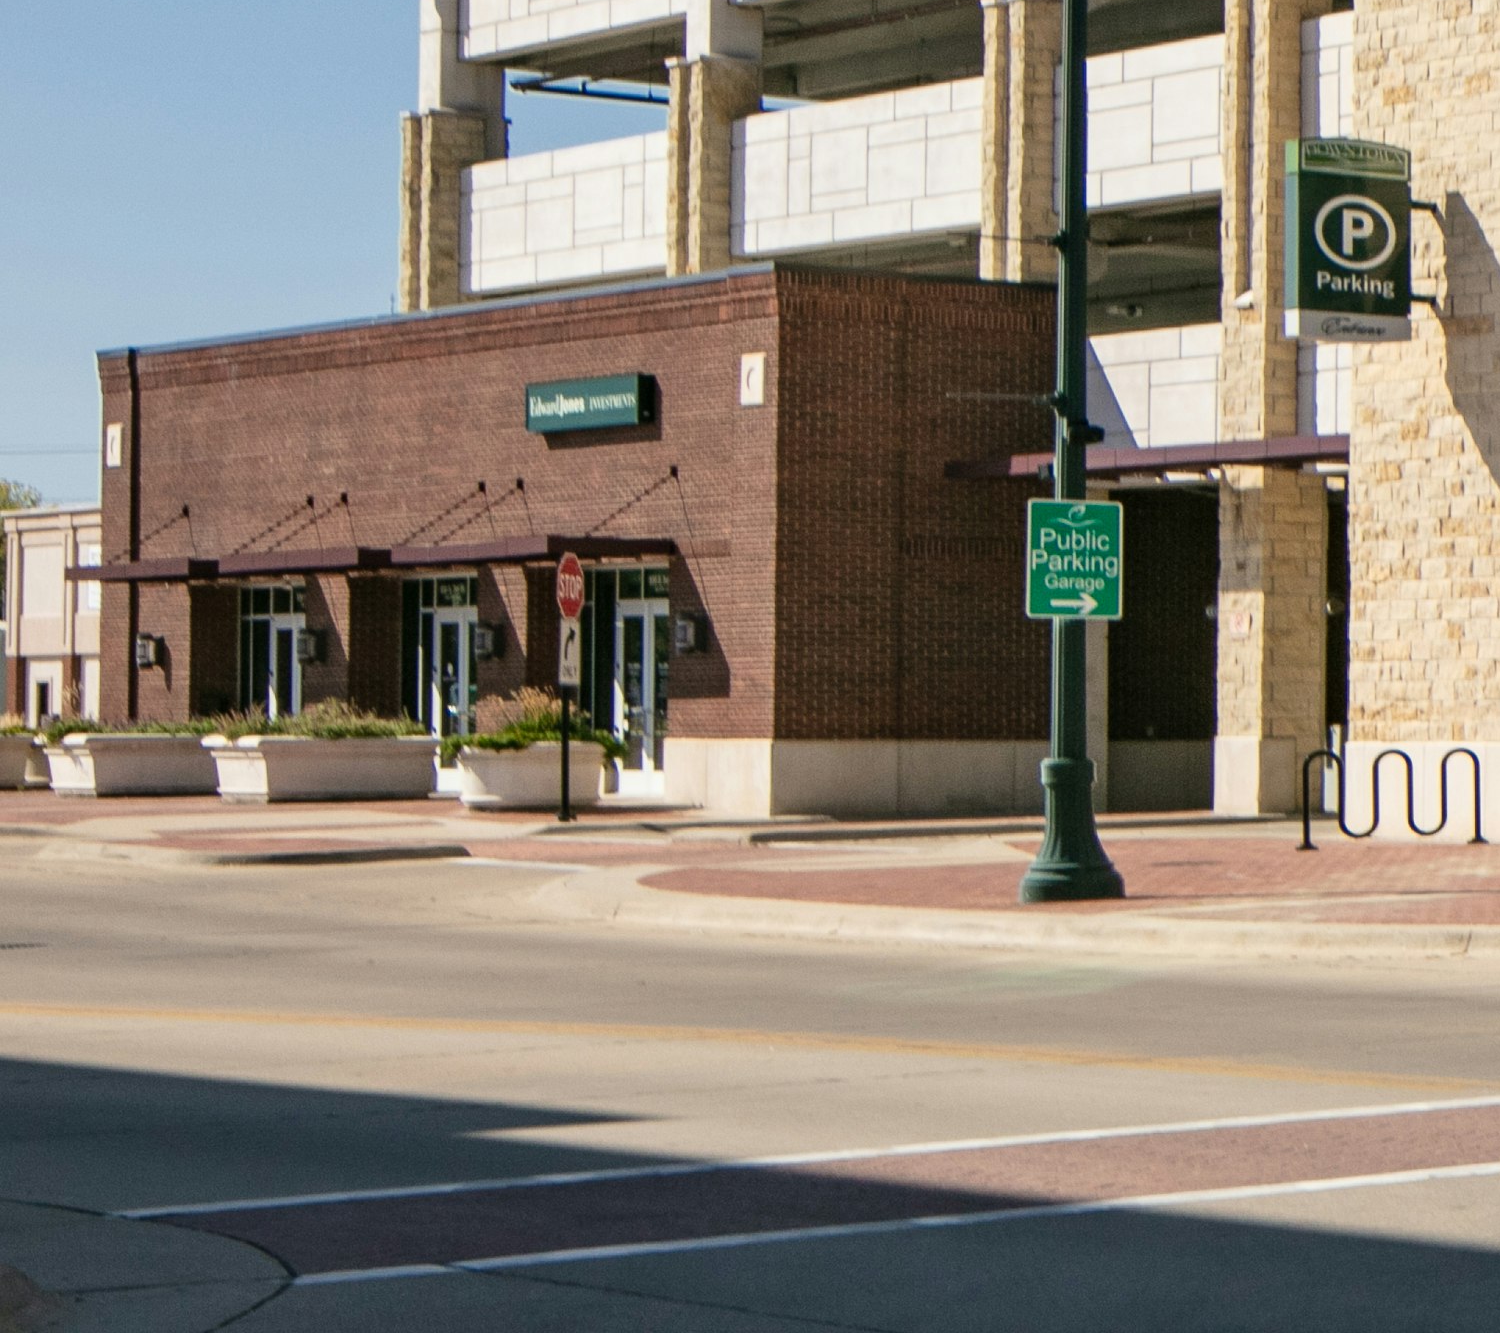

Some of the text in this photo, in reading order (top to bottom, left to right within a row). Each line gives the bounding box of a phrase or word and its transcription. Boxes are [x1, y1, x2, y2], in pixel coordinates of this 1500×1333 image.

[1341, 207, 1375, 257] P
[1316, 270, 1396, 300] Parking
[1040, 527, 1110, 551] Public
[1031, 548, 1119, 578] Parking
[559, 573, 583, 600] STOP
[1044, 572, 1105, 594] Garage
